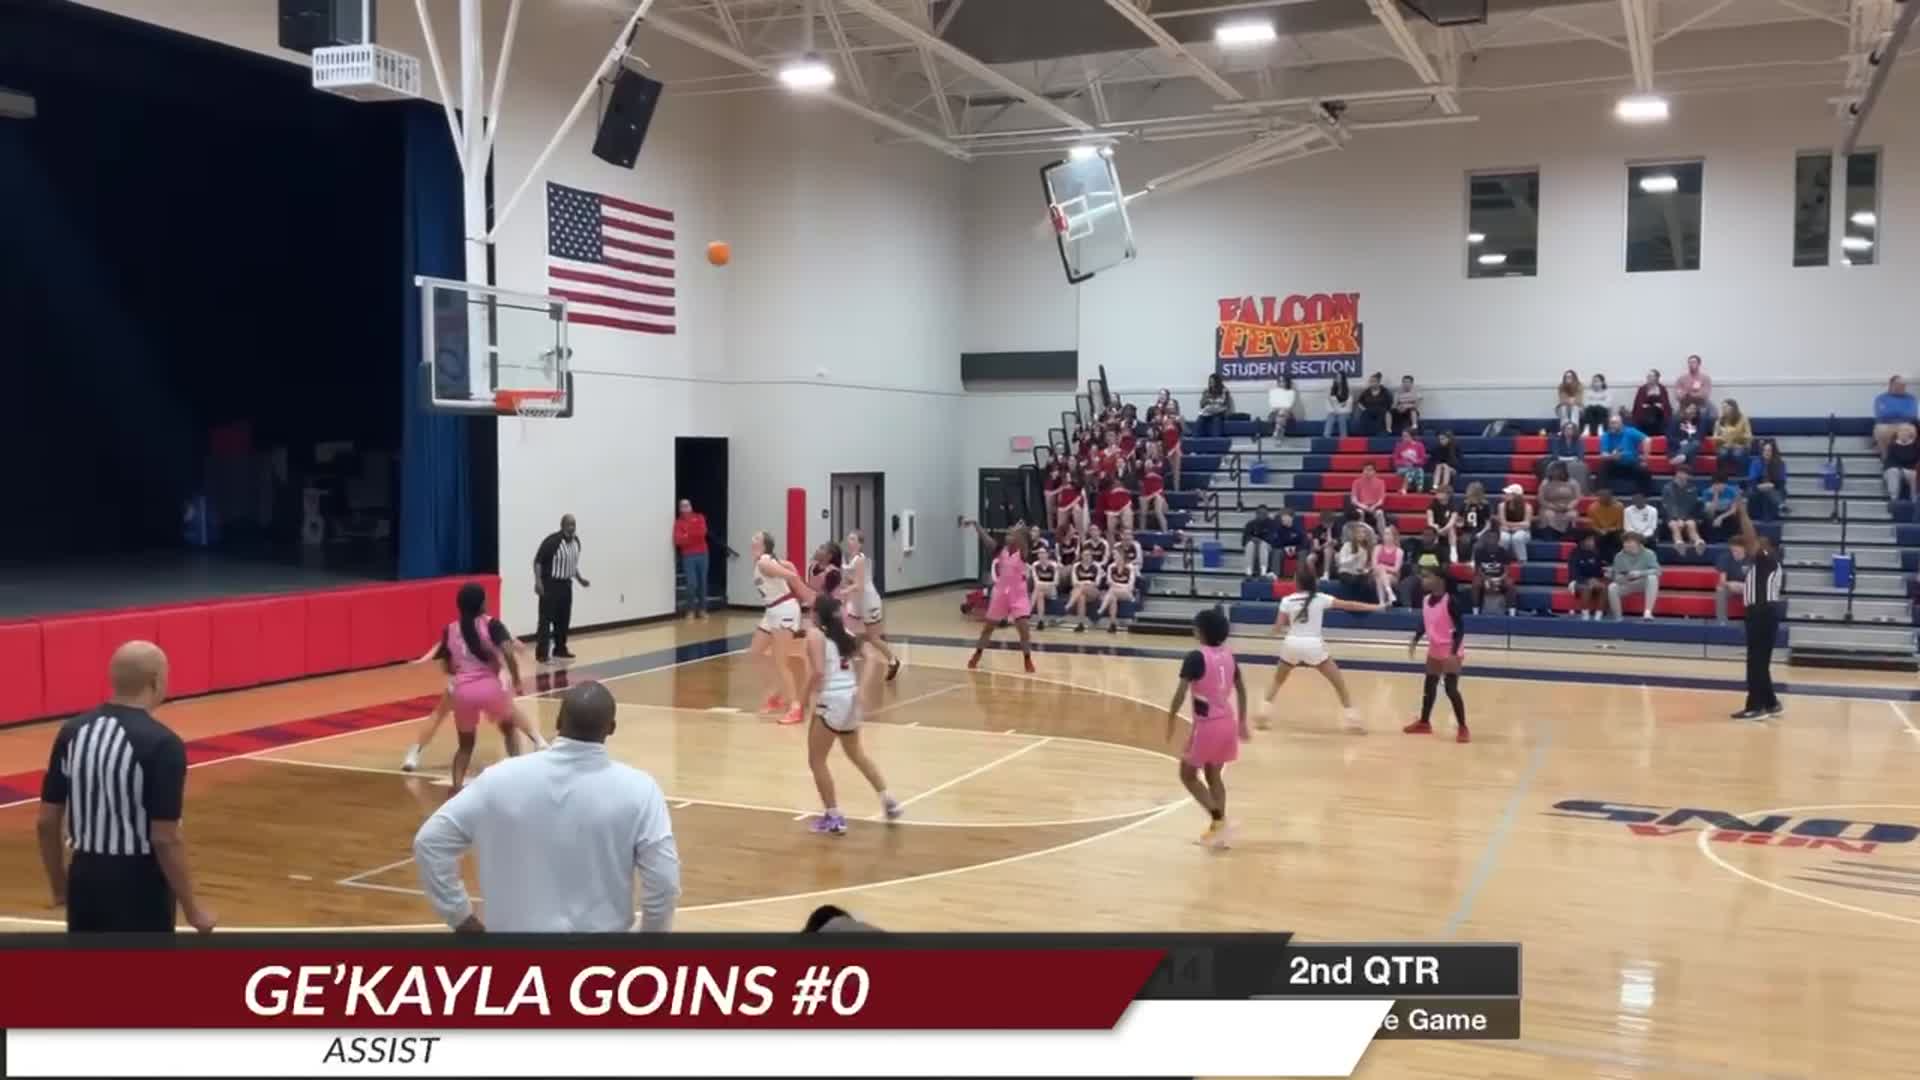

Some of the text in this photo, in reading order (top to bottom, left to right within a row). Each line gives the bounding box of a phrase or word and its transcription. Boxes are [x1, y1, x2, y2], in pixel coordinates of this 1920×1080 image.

[1217, 292, 1361, 325] FALCON
[1218, 320, 1361, 359] FEVER
[1221, 359, 1356, 377] STUDENT SECTION
